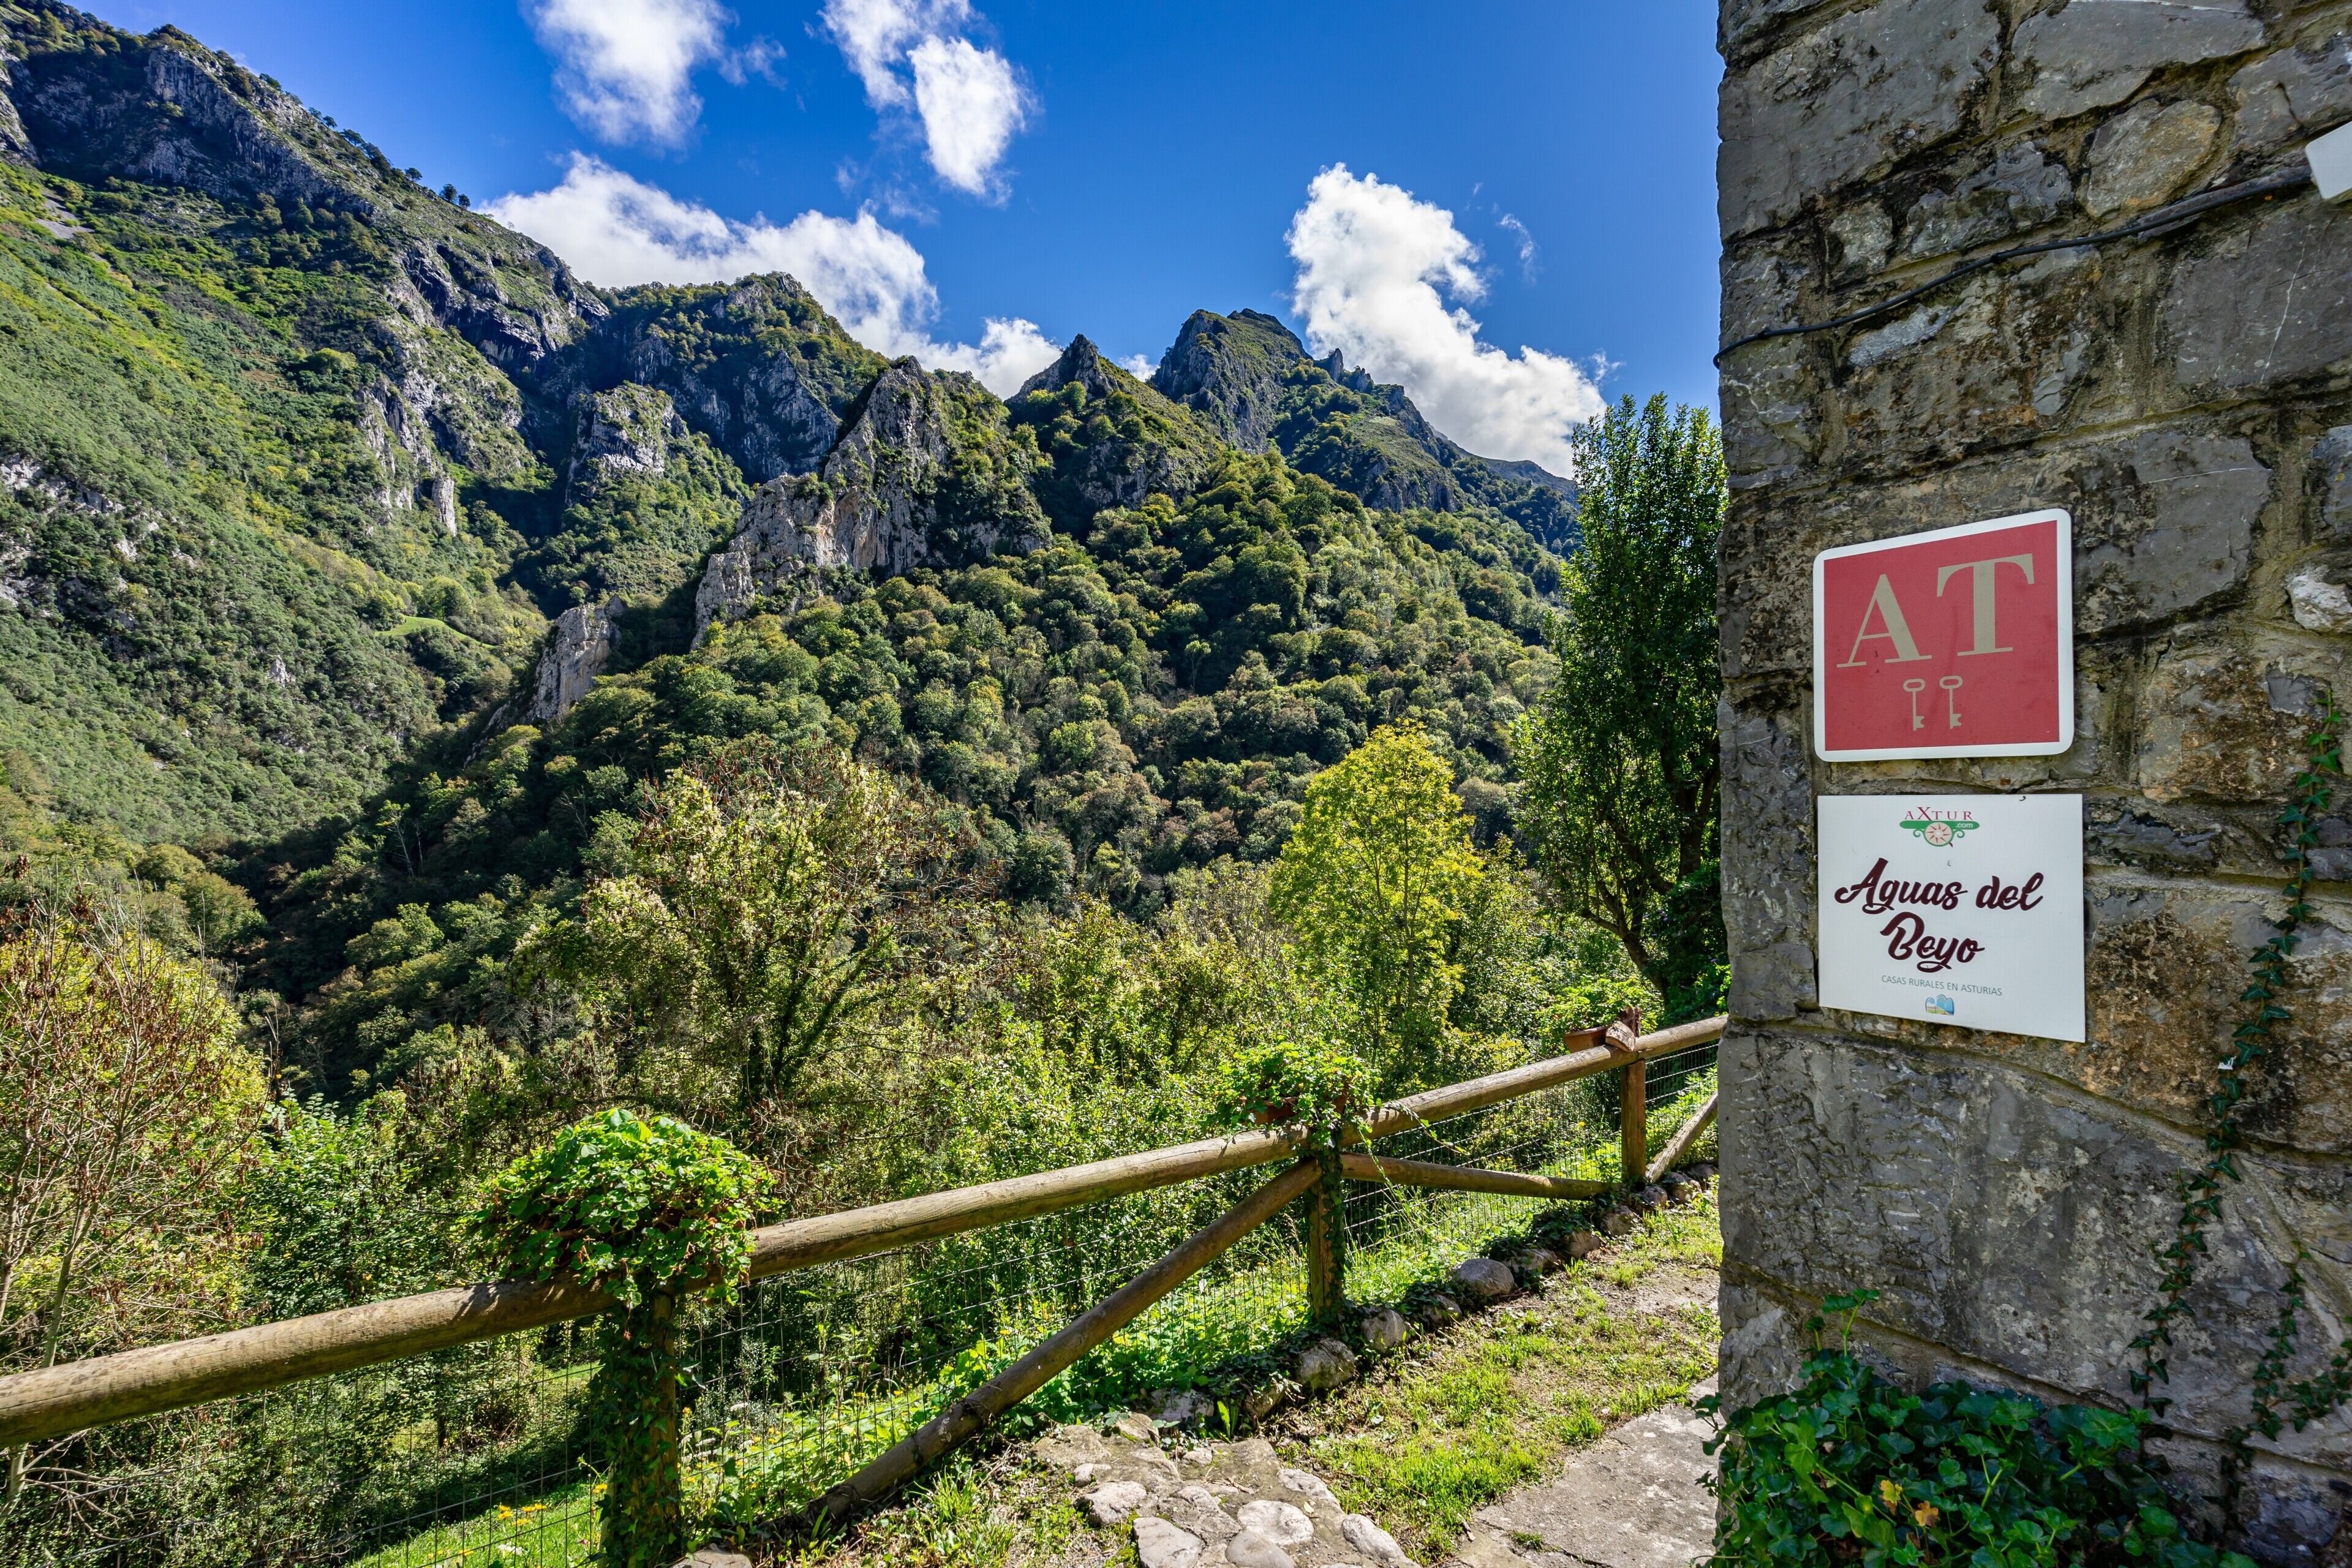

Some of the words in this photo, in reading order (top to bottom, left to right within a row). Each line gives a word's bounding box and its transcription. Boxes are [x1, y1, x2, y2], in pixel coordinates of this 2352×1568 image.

[1836, 553, 2035, 668] AT
[1834, 858, 1967, 914] Aguas
[1975, 872, 2044, 911] del
[1880, 911, 1985, 973] Beyo
[1882, 975, 1906, 985] CASAS
[1909, 978, 1945, 989] RURALES
[1947, 982, 1958, 991] EN
[1961, 984, 2002, 996] ASTURIAS
